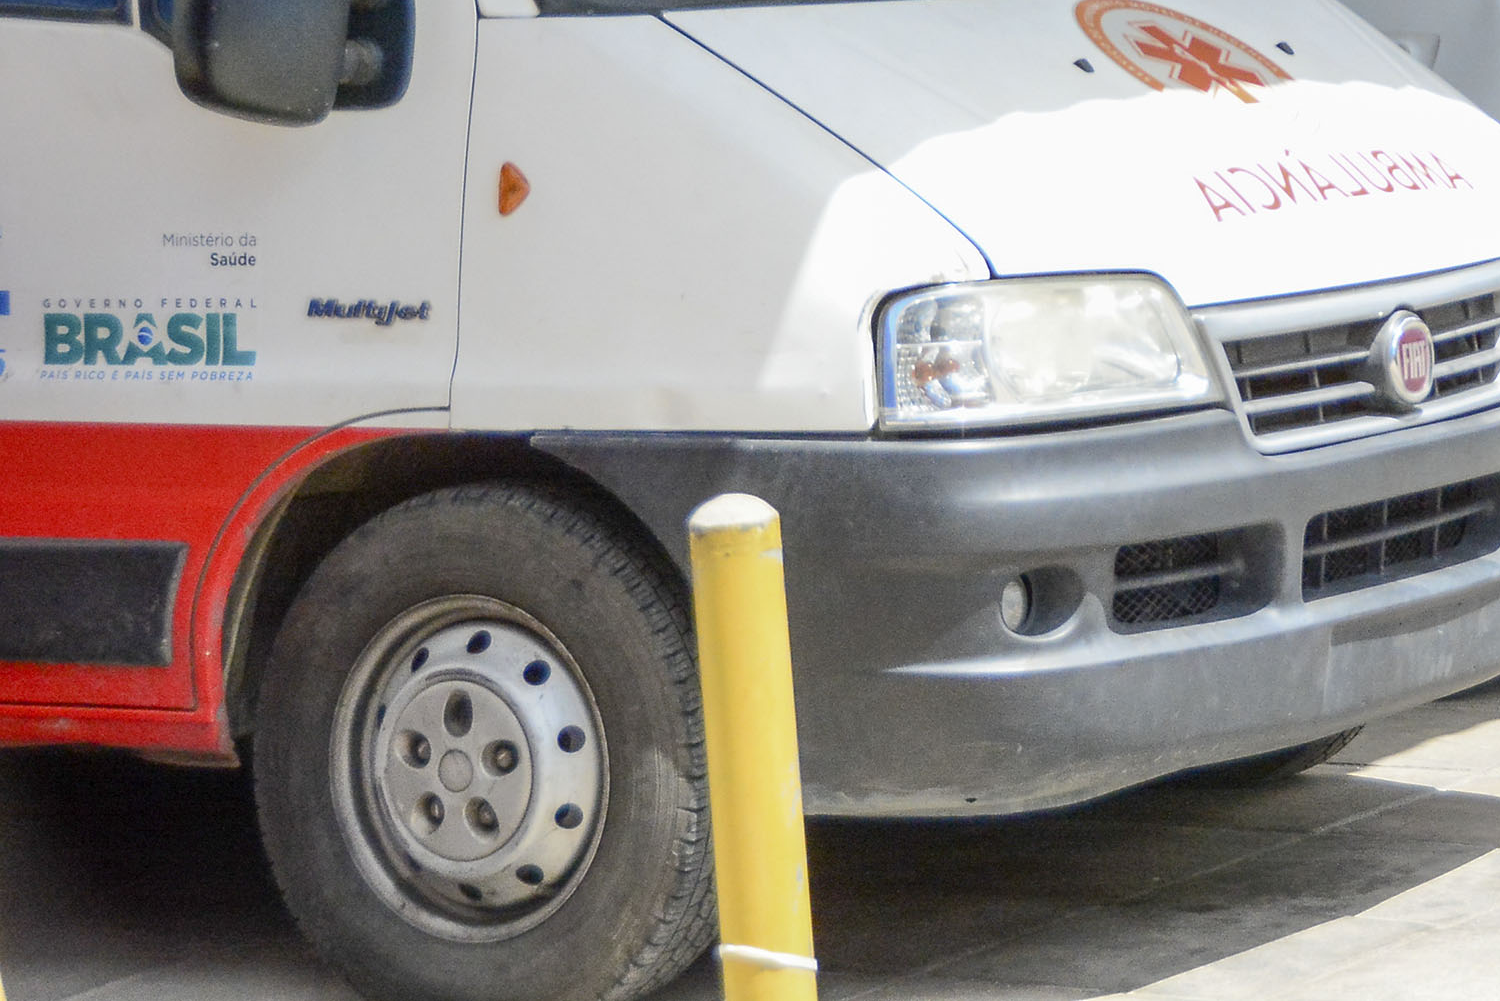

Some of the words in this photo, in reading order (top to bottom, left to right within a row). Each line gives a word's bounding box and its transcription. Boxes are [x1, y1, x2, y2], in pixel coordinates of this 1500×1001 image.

[162, 233, 234, 247] Ministério
[239, 233, 257, 247] da
[210, 252, 257, 267] Saúde
[42, 298, 144, 309] GOVERNO
[161, 298, 257, 309] FEDERAL
[44, 312, 257, 366] BRASIL
[1401, 339, 1429, 381] FIAT
[75, 370, 106, 380] RICO
[159, 370, 185, 380] SEM
[191, 370, 254, 381] POBREZA
